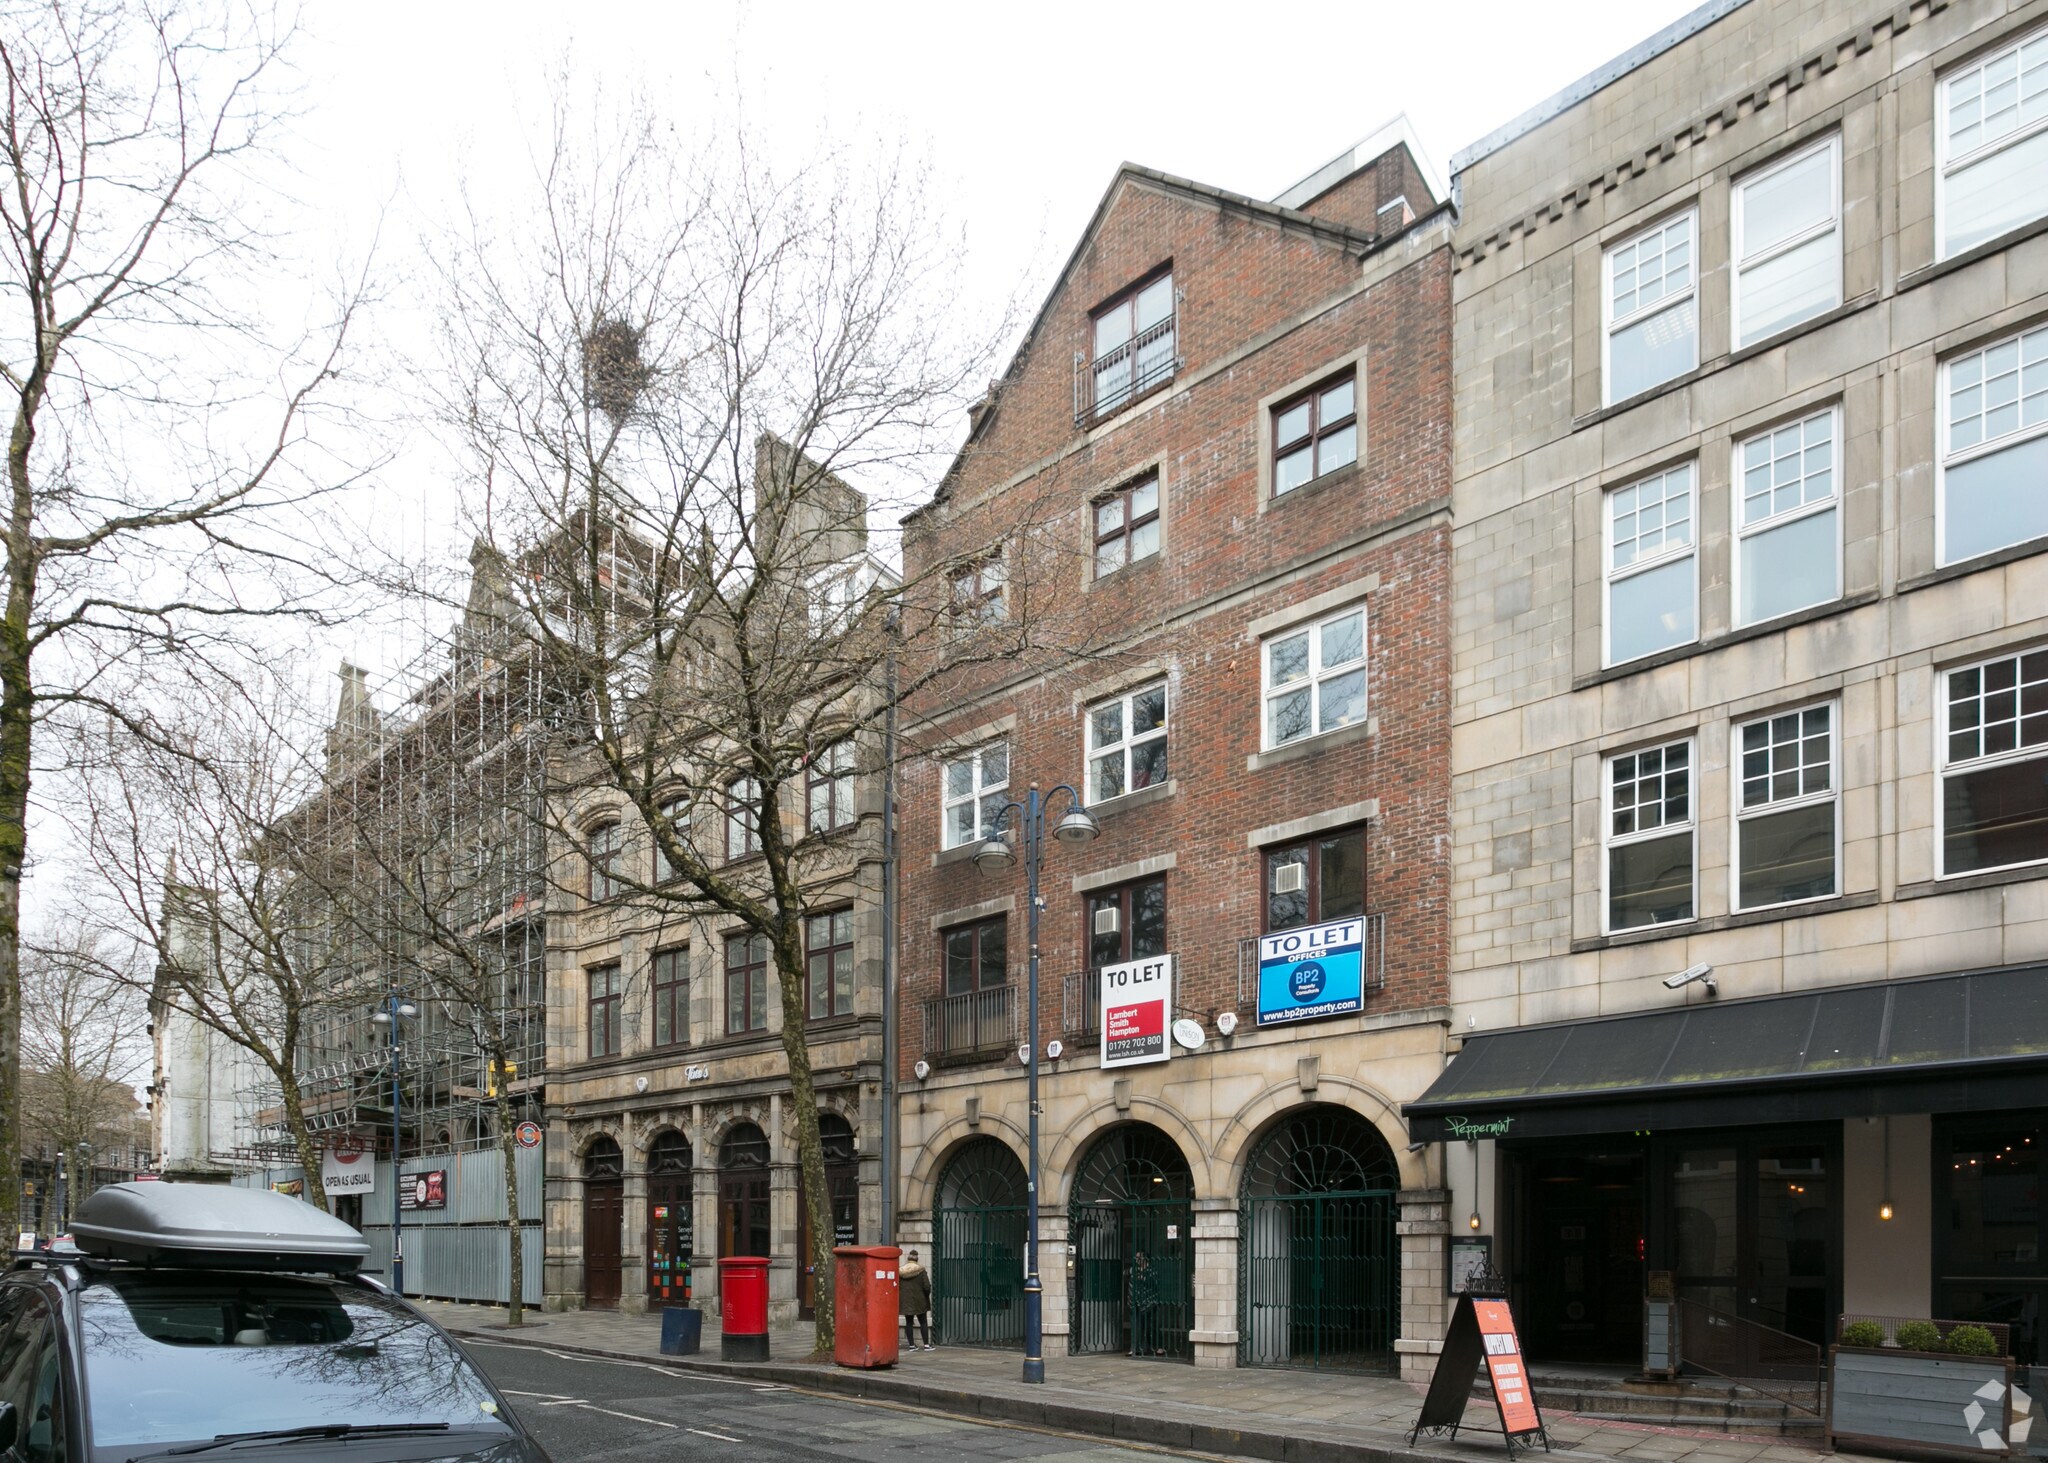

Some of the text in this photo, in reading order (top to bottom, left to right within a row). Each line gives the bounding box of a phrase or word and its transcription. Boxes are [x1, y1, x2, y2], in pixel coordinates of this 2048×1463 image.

[1269, 925, 1354, 954] TO LET
[1288, 949, 1327, 963] OFFICES
[1107, 963, 1164, 988] TO LET
[1295, 969, 1319, 984] BP2
[1109, 1008, 1138, 1020] Lambert
[1263, 1000, 1357, 1021] www.bp2property.com
[1109, 1019, 1129, 1029] Smith
[1109, 1026, 1140, 1037] Hampton
[1108, 1035, 1161, 1050] 01792 702 800
[1108, 1049, 1144, 1059] www.lsh.co.uk
[1444, 1116, 1516, 1140] Peppermint
[325, 1173, 371, 1187] OPEN AS USUAL
